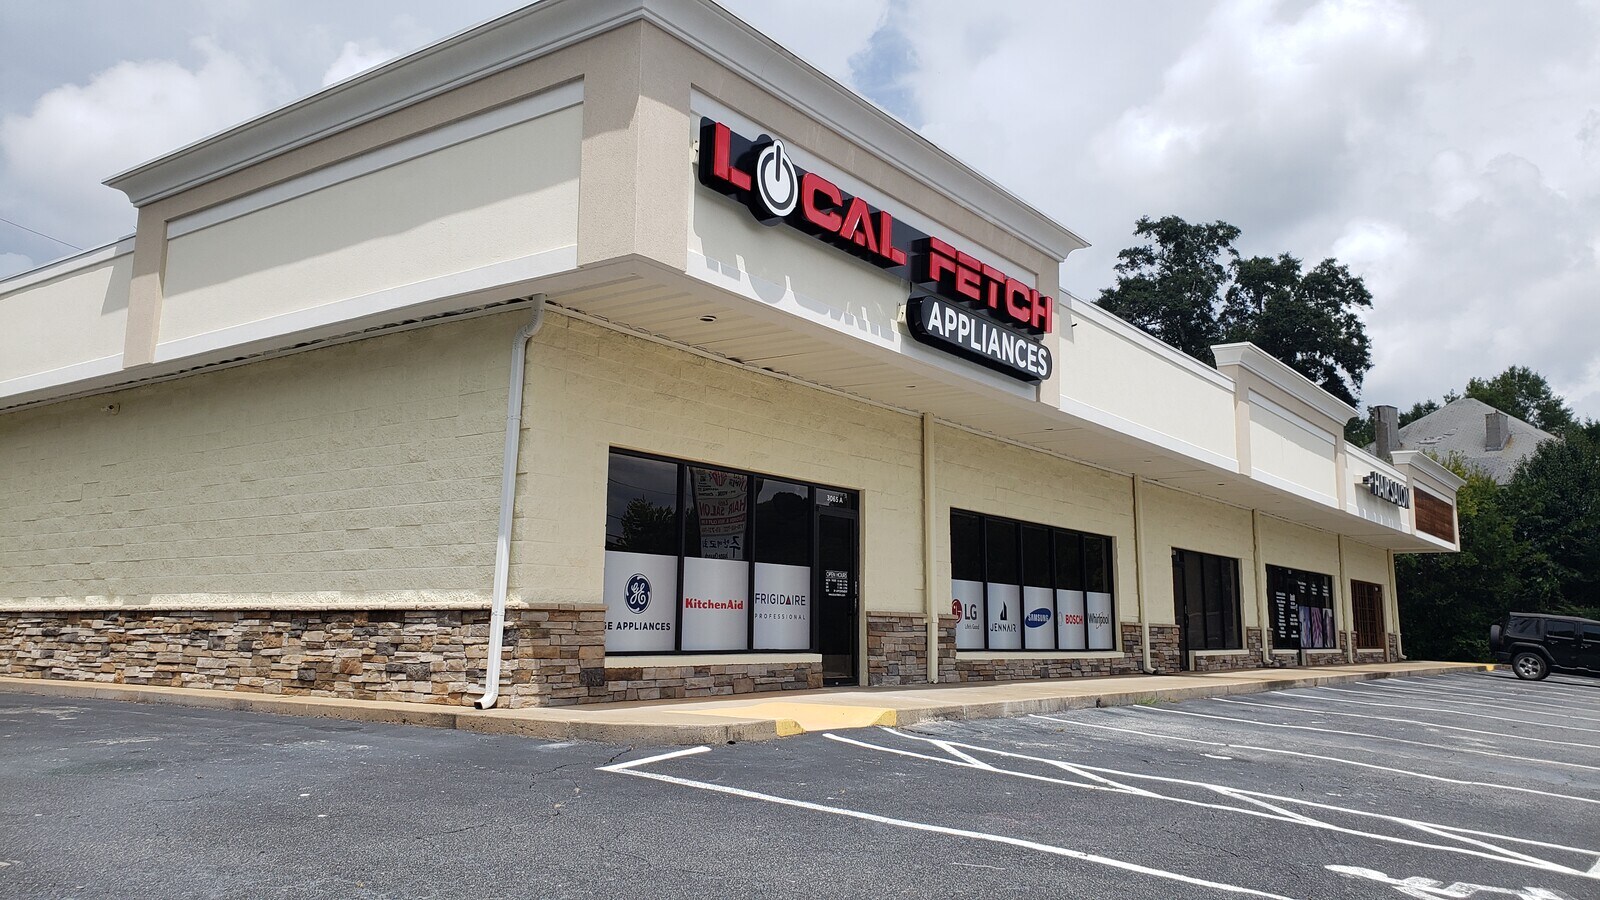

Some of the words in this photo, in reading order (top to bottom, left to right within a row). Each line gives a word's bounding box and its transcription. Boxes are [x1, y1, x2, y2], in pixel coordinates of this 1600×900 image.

[712, 121, 906, 266] LOCAL
[929, 236, 1053, 334] FETCH
[927, 301, 1048, 377] APPLIANCES
[685, 598, 744, 610] KitchenAid
[755, 593, 806, 606] FRIGIDAIRE
[964, 603, 977, 620] LG
[1028, 613, 1049, 622] SAMSUNG
[1065, 614, 1083, 624] BOSCH
[1088, 611, 1110, 630] Whirlpool
[616, 621, 671, 631] APPLIANCES
[990, 622, 1017, 632] JENNAIR
